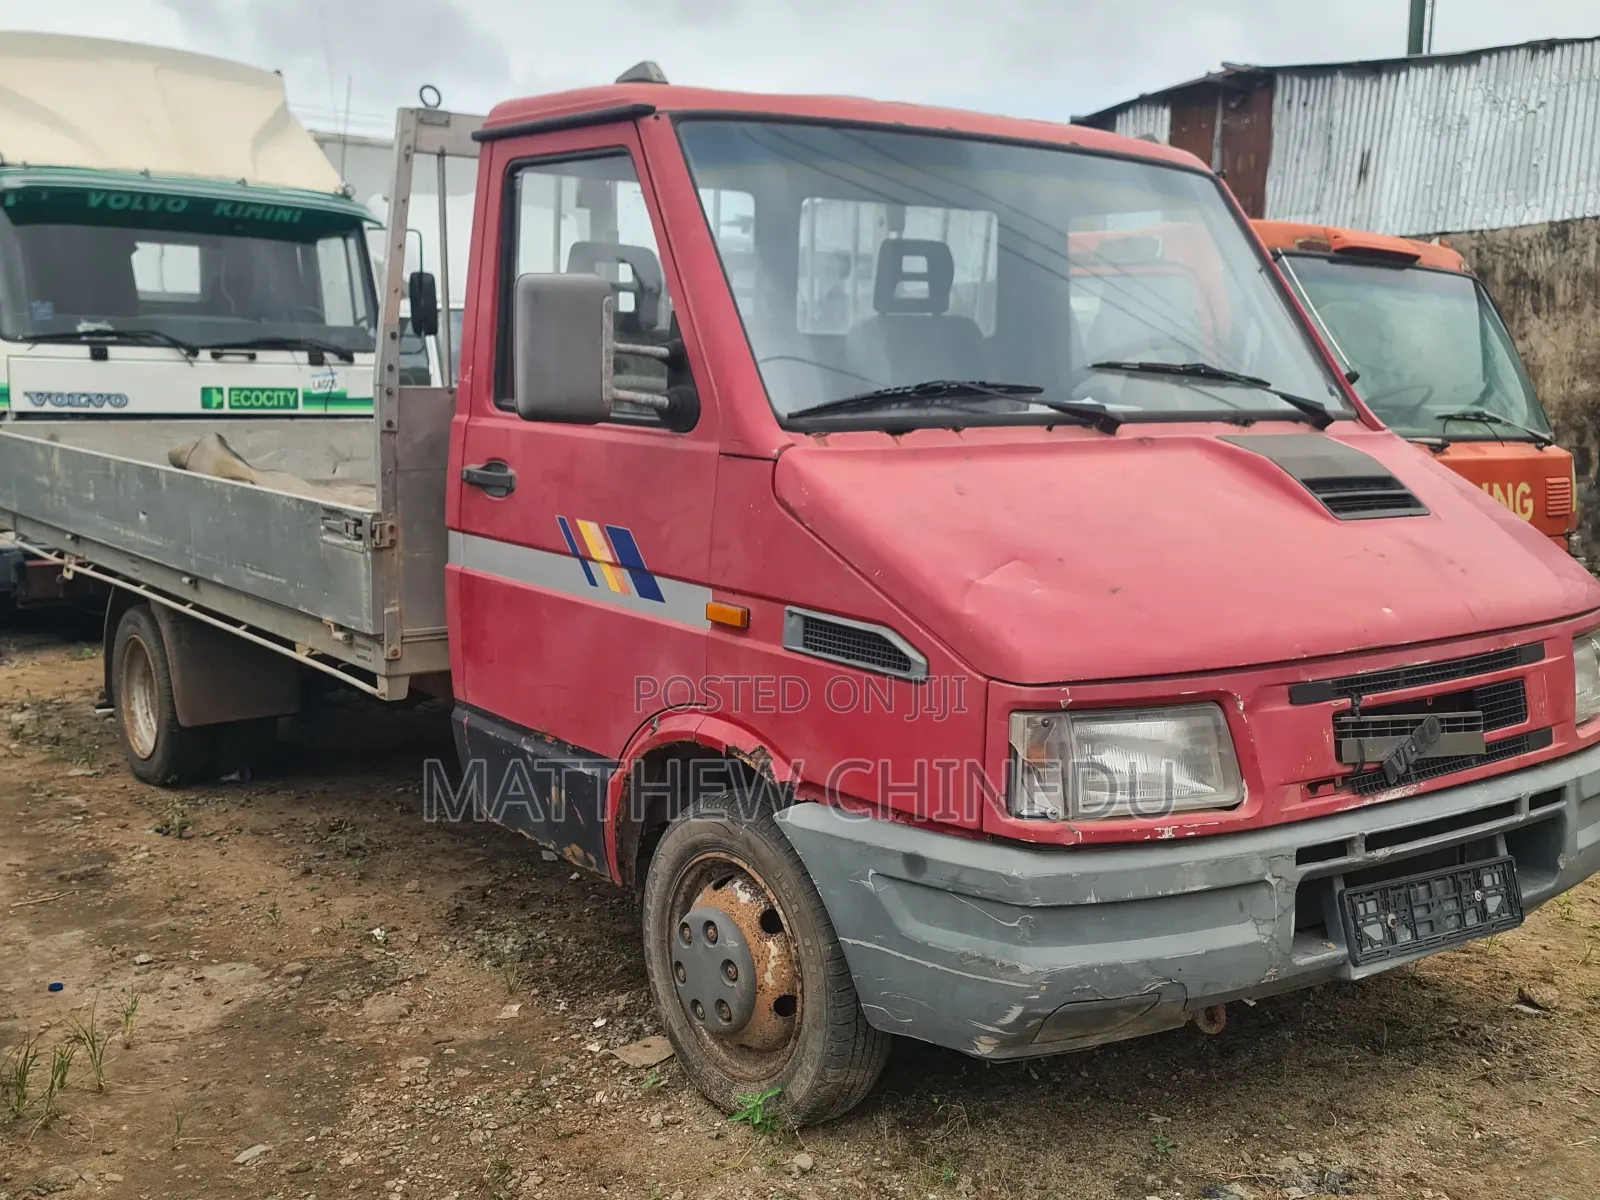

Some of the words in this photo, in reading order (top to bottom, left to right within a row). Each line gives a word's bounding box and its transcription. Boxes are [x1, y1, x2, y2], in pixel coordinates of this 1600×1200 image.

[87, 191, 189, 214] VOLVO
[213, 201, 303, 224] RIMINI
[23, 392, 128, 408] VOLVO
[230, 389, 296, 407] ECOCITY
[1482, 482, 1534, 522] NG
